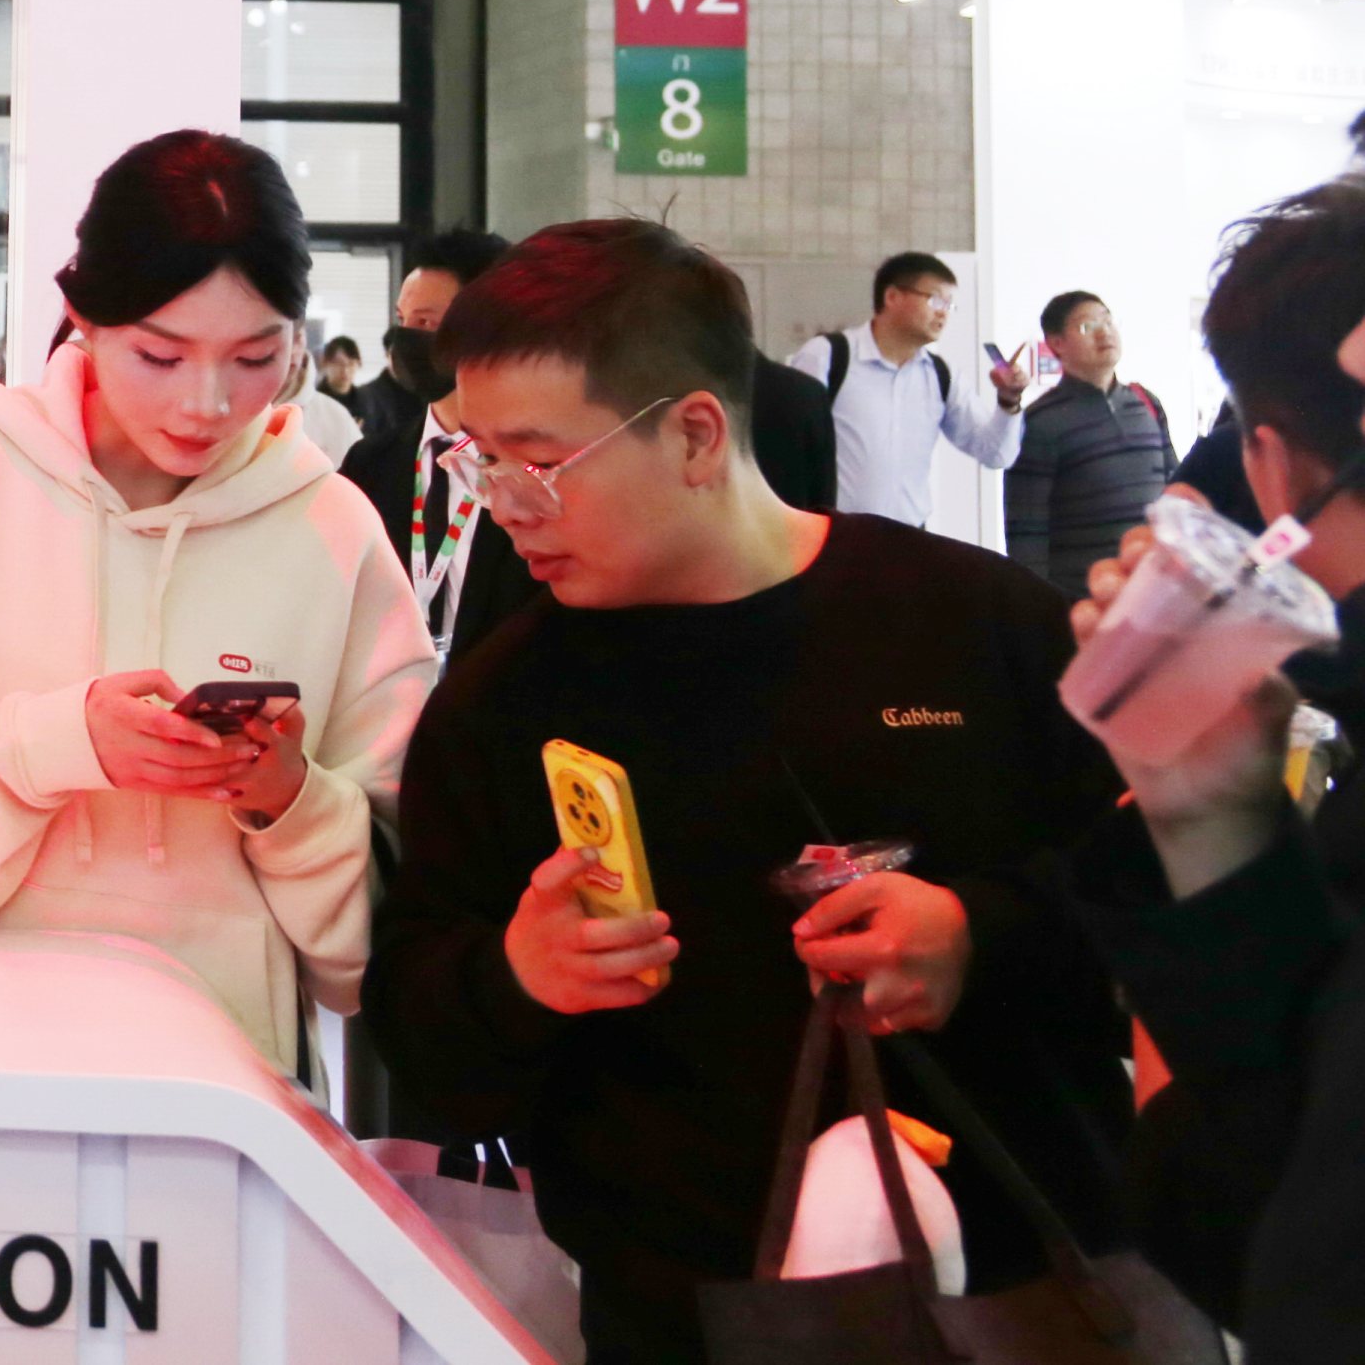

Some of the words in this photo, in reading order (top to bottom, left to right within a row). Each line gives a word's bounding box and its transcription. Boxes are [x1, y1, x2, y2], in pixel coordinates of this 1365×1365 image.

[660, 78, 703, 140] 8
[656, 149, 706, 168] Gate
[881, 707, 965, 728] Cabbeen
